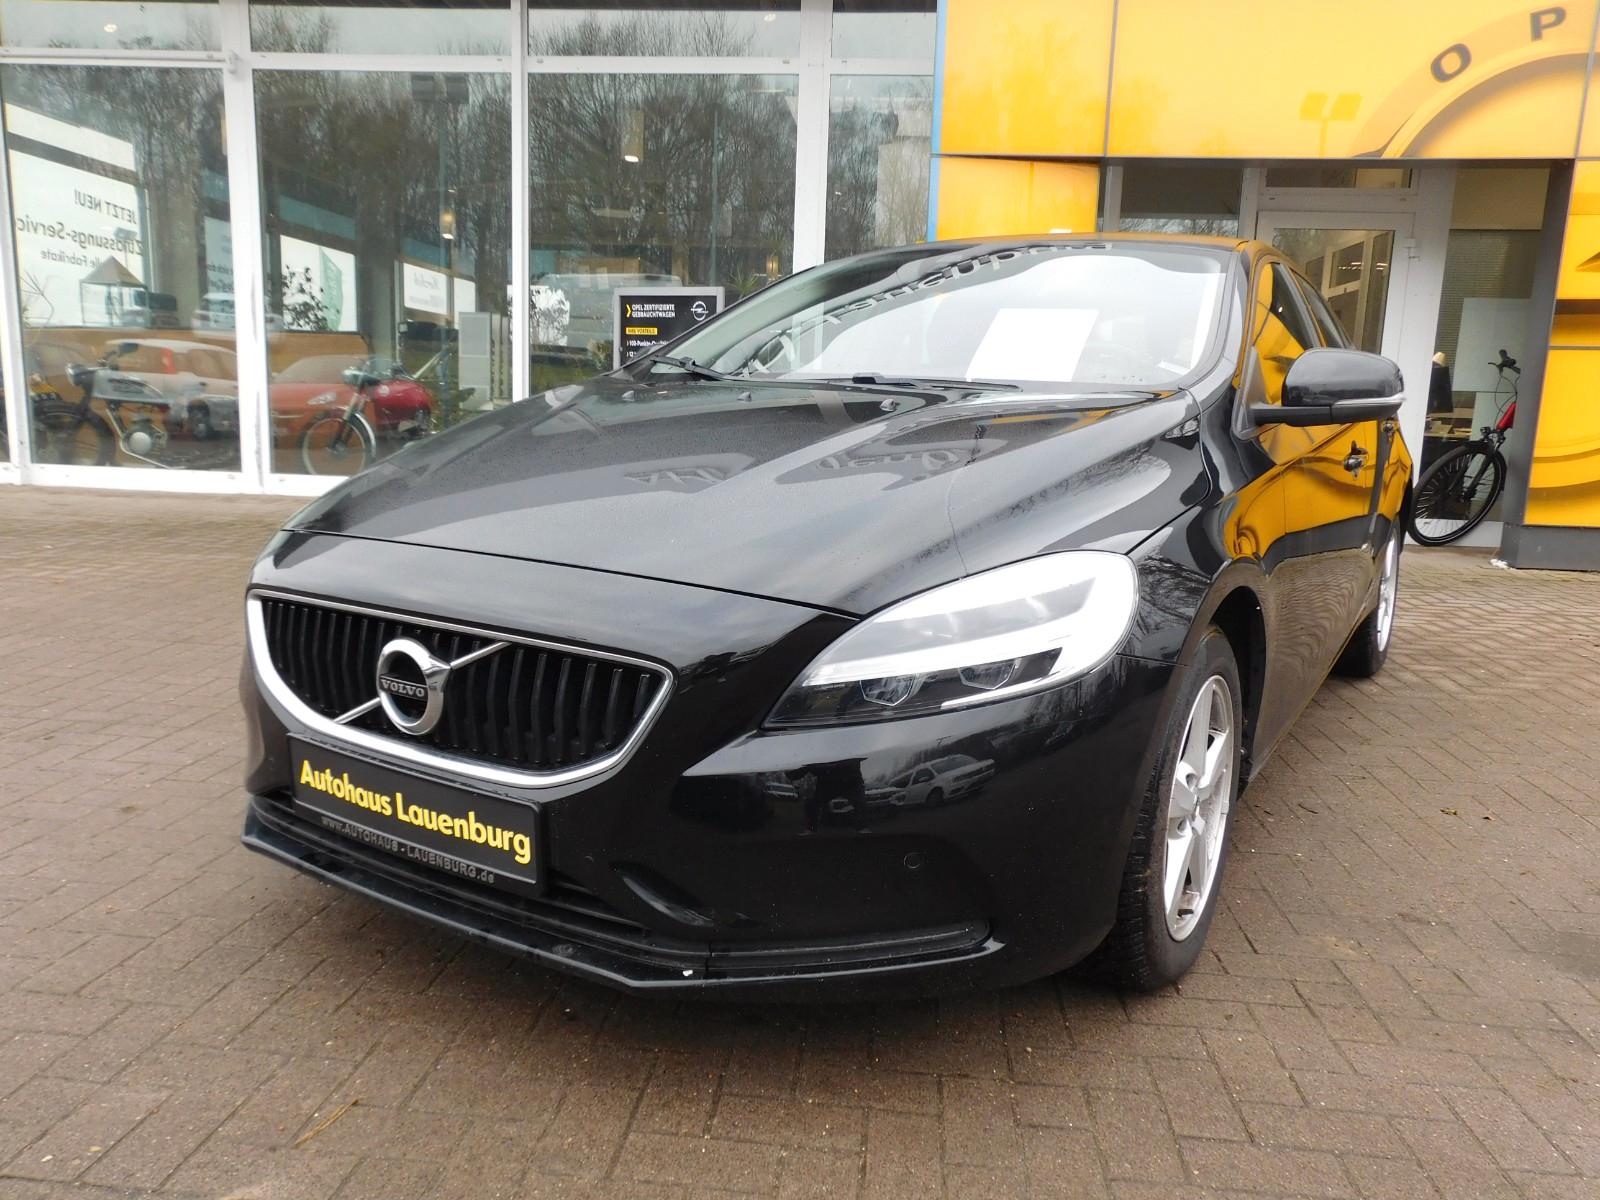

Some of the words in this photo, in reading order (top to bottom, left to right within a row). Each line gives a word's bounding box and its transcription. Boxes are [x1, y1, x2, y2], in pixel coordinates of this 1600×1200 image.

[381, 679, 425, 698] VOLVO
[300, 759, 393, 817] Autohaus
[396, 792, 532, 865] Lauenburg
